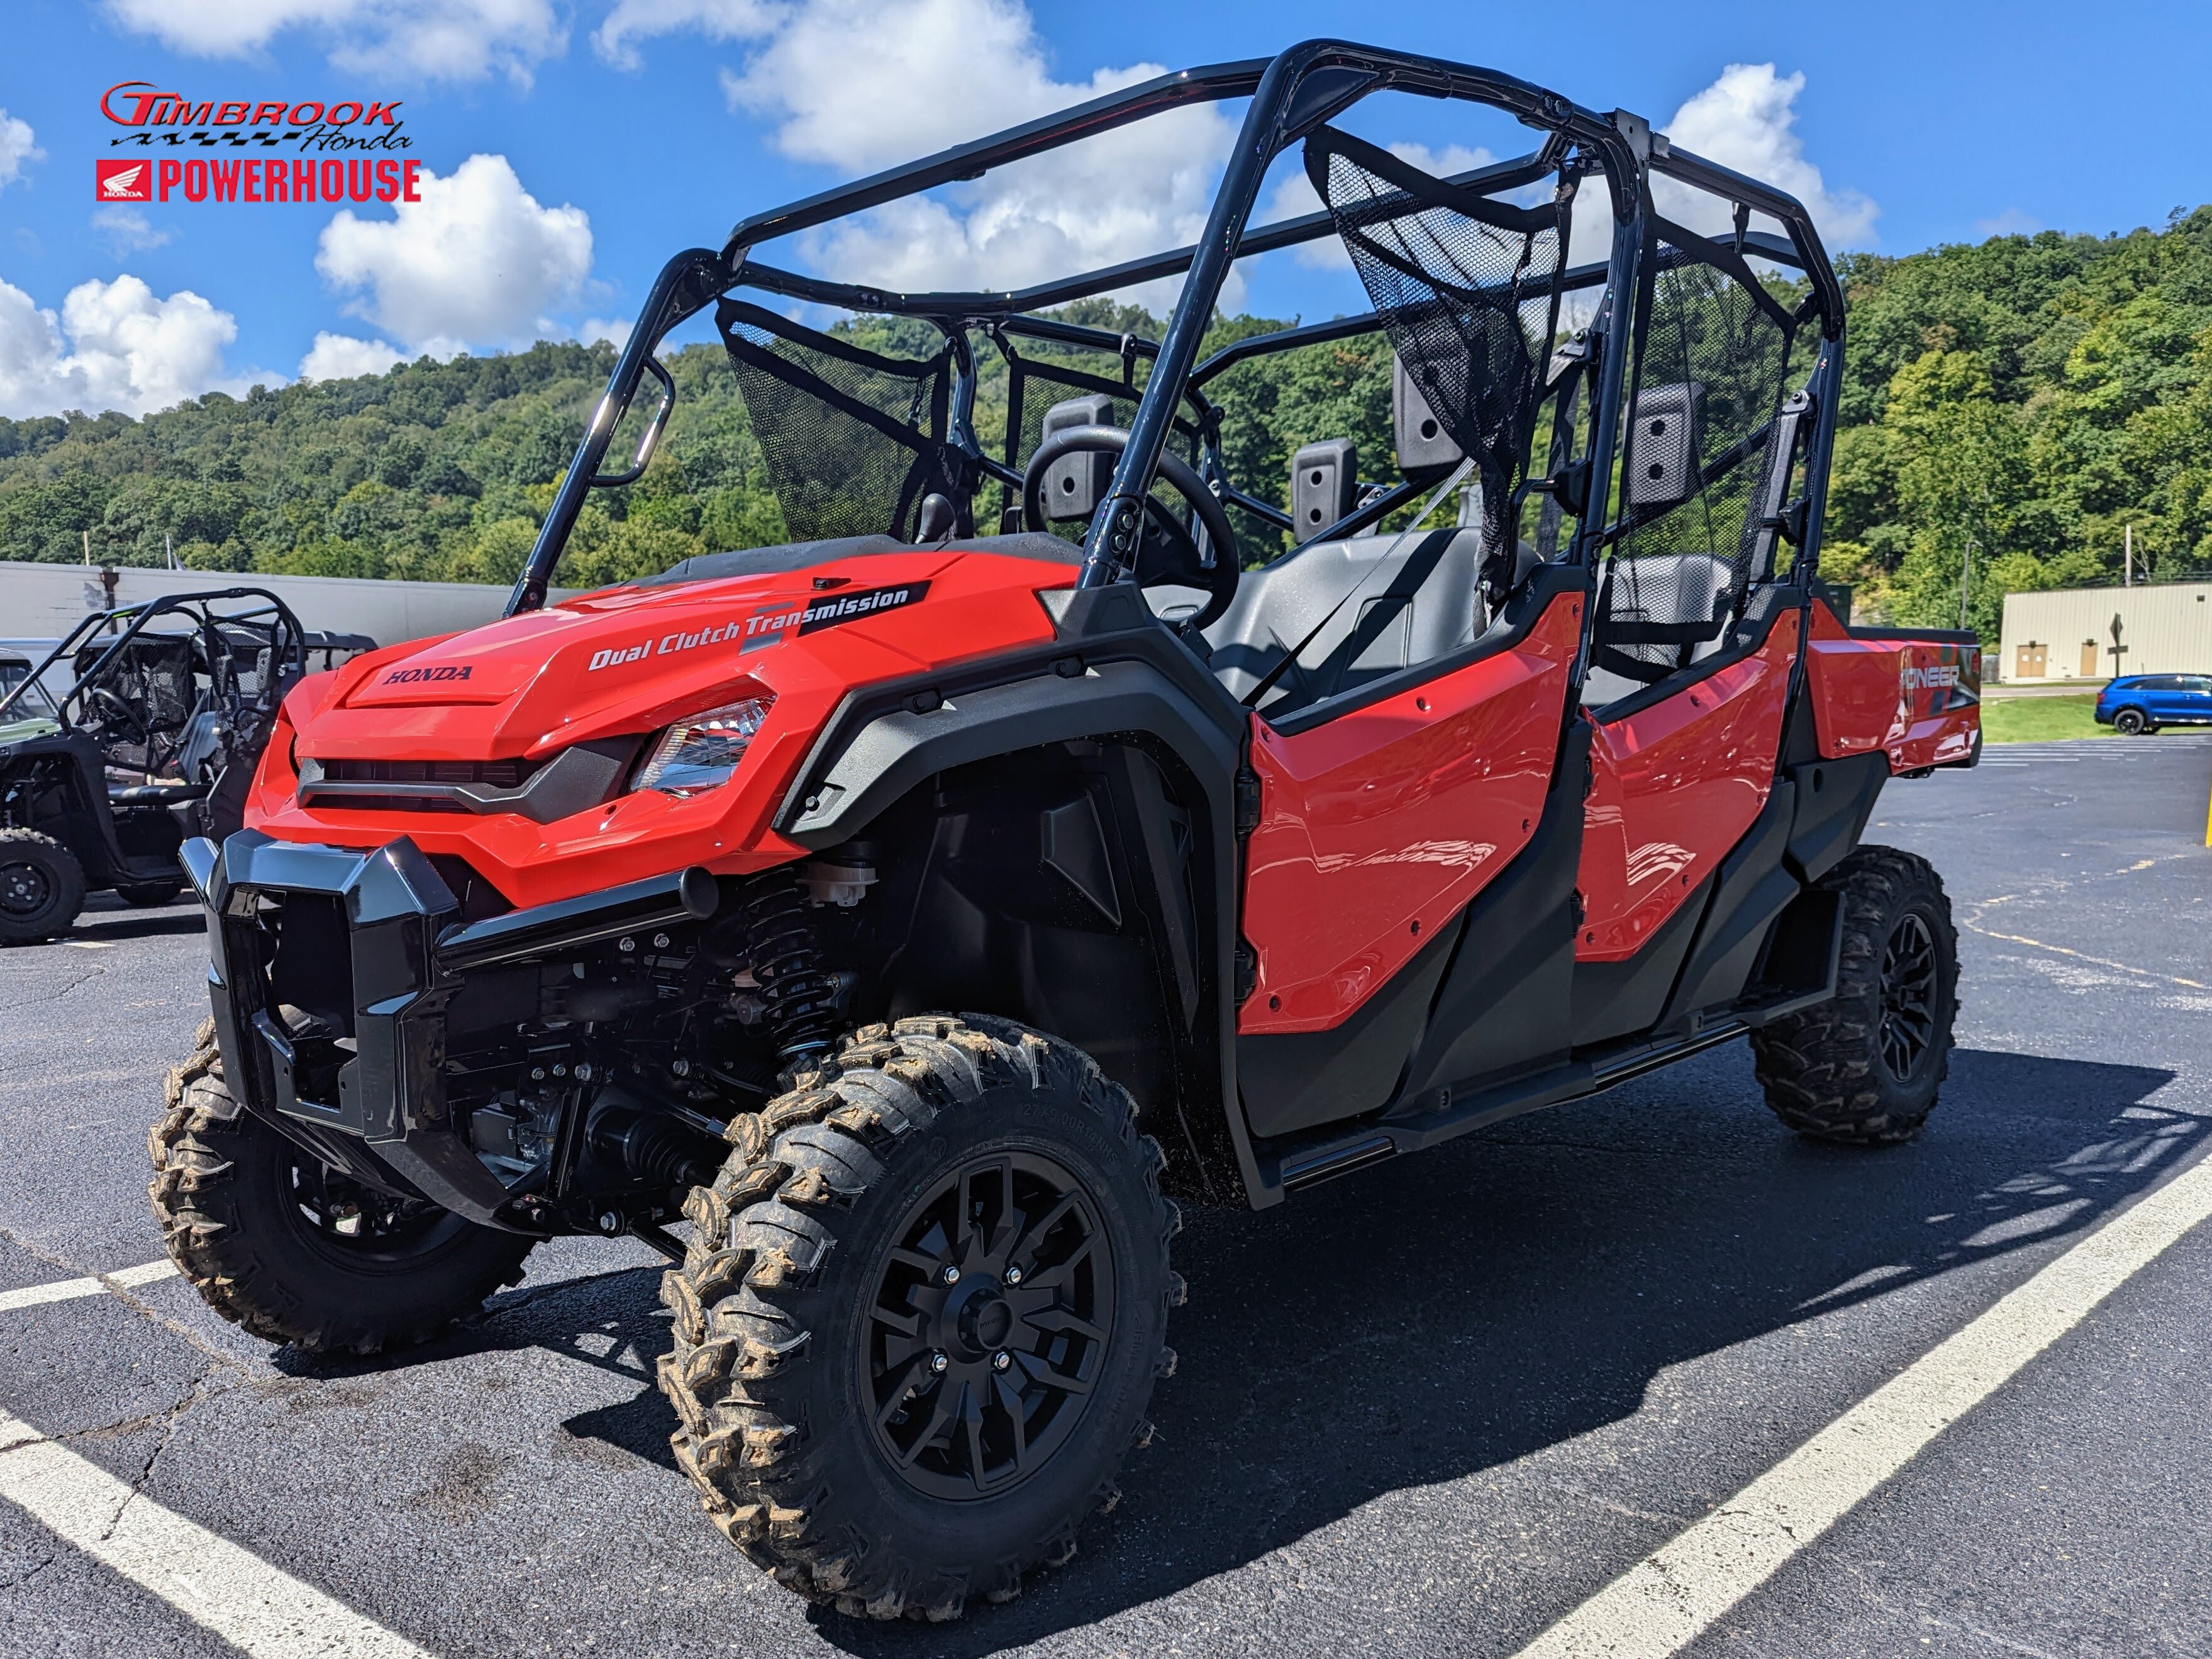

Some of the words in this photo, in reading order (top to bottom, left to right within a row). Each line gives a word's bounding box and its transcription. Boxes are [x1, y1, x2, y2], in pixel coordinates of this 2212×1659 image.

[588, 639, 652, 671] Dual
[657, 622, 740, 656] Clutch
[745, 589, 909, 635] Transmission
[382, 666, 473, 685] HONDA
